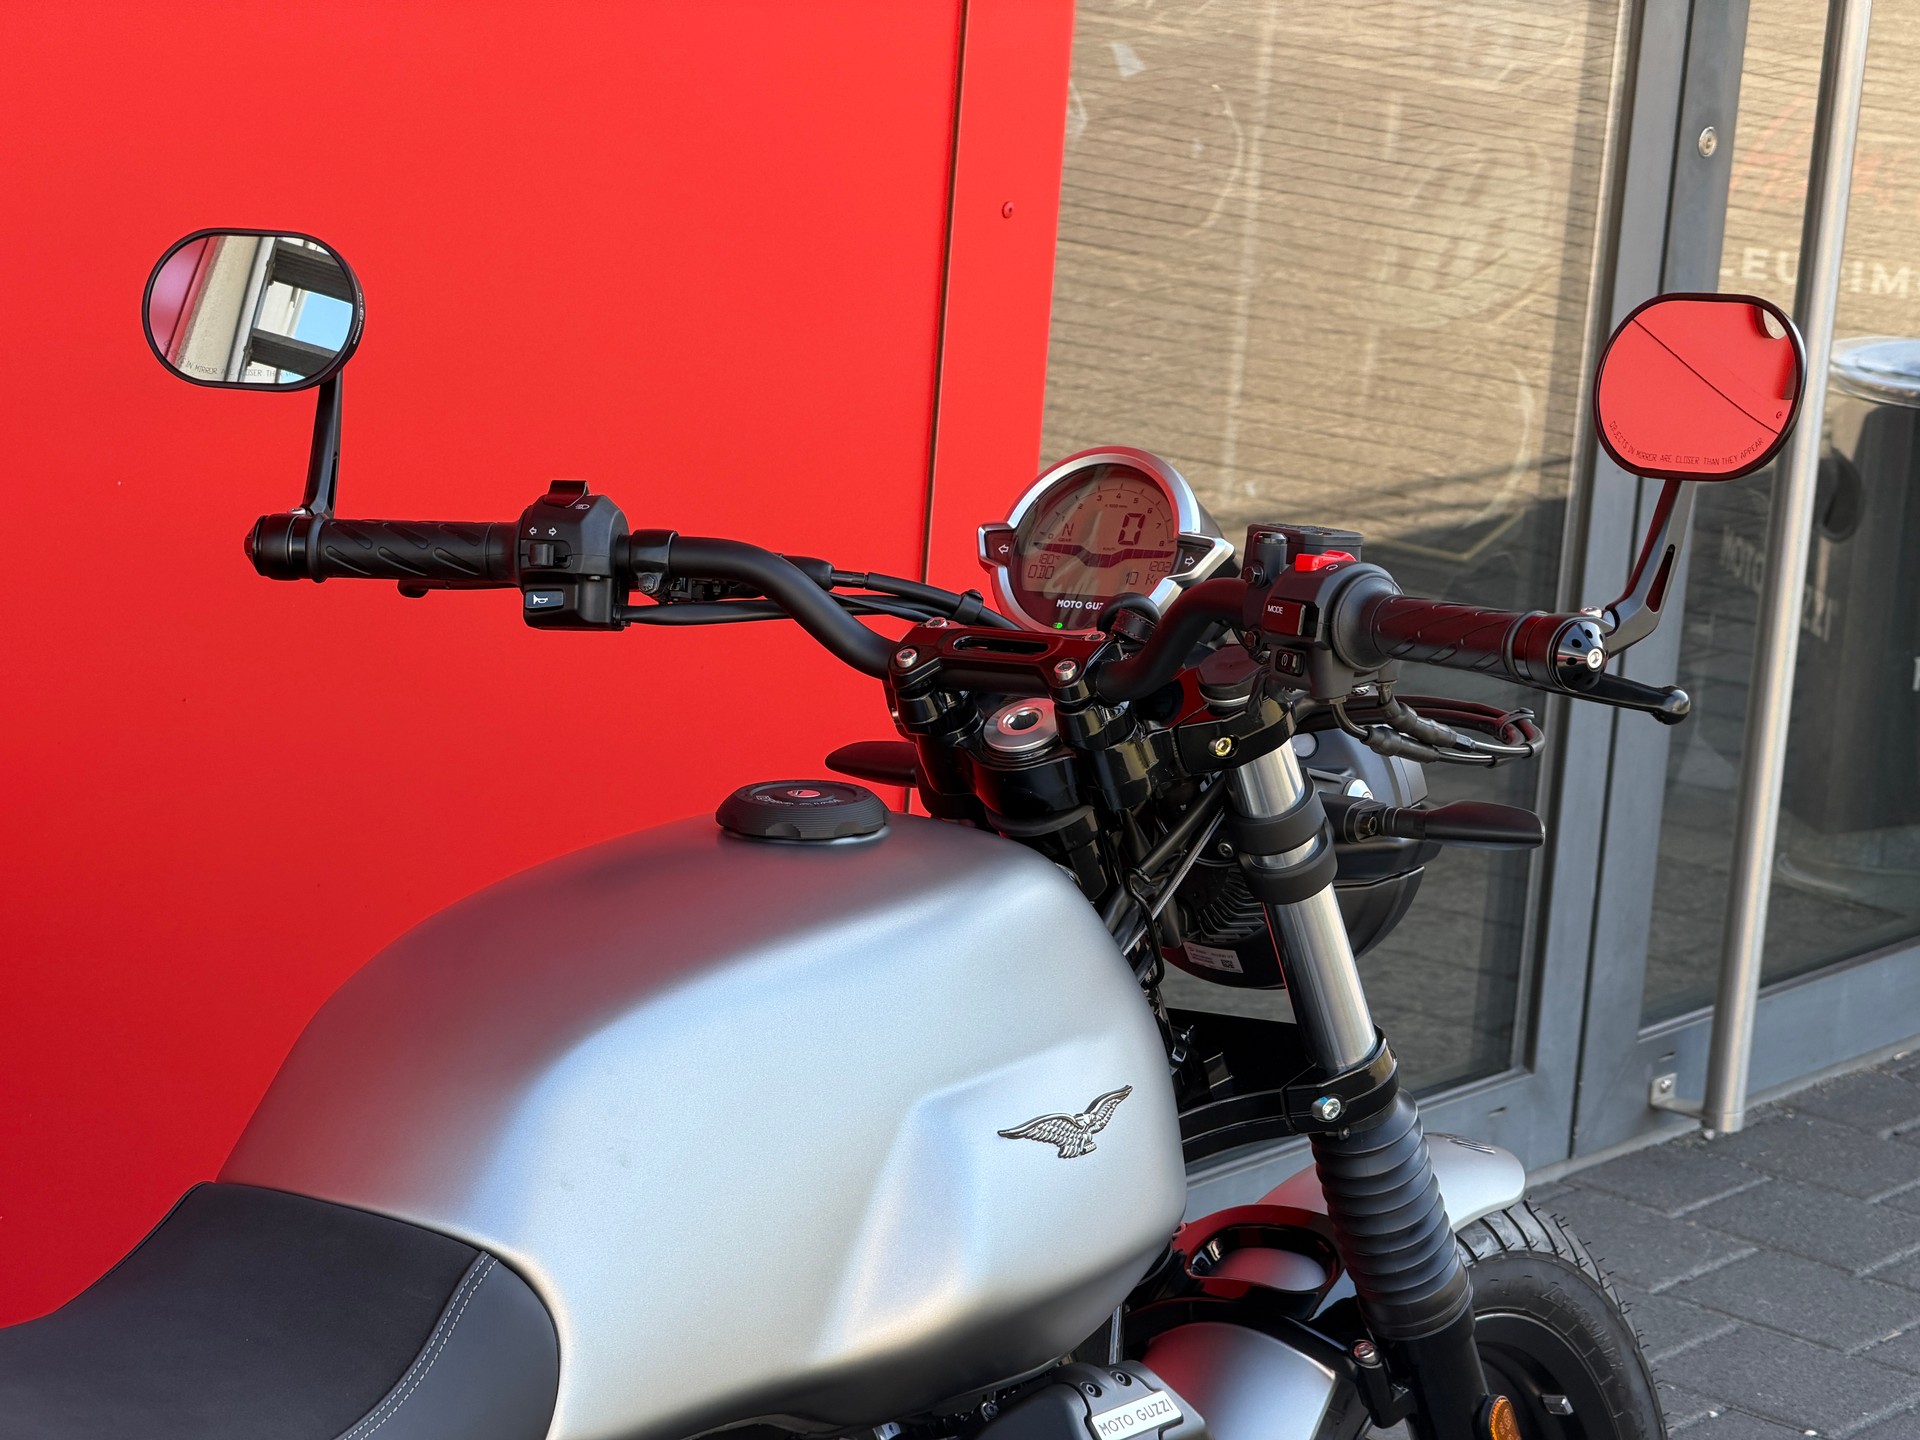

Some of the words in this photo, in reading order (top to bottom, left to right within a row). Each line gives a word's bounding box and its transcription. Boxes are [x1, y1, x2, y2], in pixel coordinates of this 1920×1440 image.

[1609, 420, 1629, 449] OBJECTS
[1636, 450, 1657, 462] MIRROR
[1660, 454, 1673, 463] ARE
[1675, 455, 1700, 465] CLOSER
[1703, 457, 1720, 466] THAN
[1721, 455, 1739, 465] THEY
[1740, 438, 1764, 459] APPEAR
[1062, 523, 1075, 537] N
[1118, 512, 1146, 545] 0
[1056, 599, 1083, 609] MOTO
[1267, 604, 1284, 615] MODE
[1098, 1414, 1134, 1437] MOTO
[1136, 1398, 1174, 1421] GUZZI
